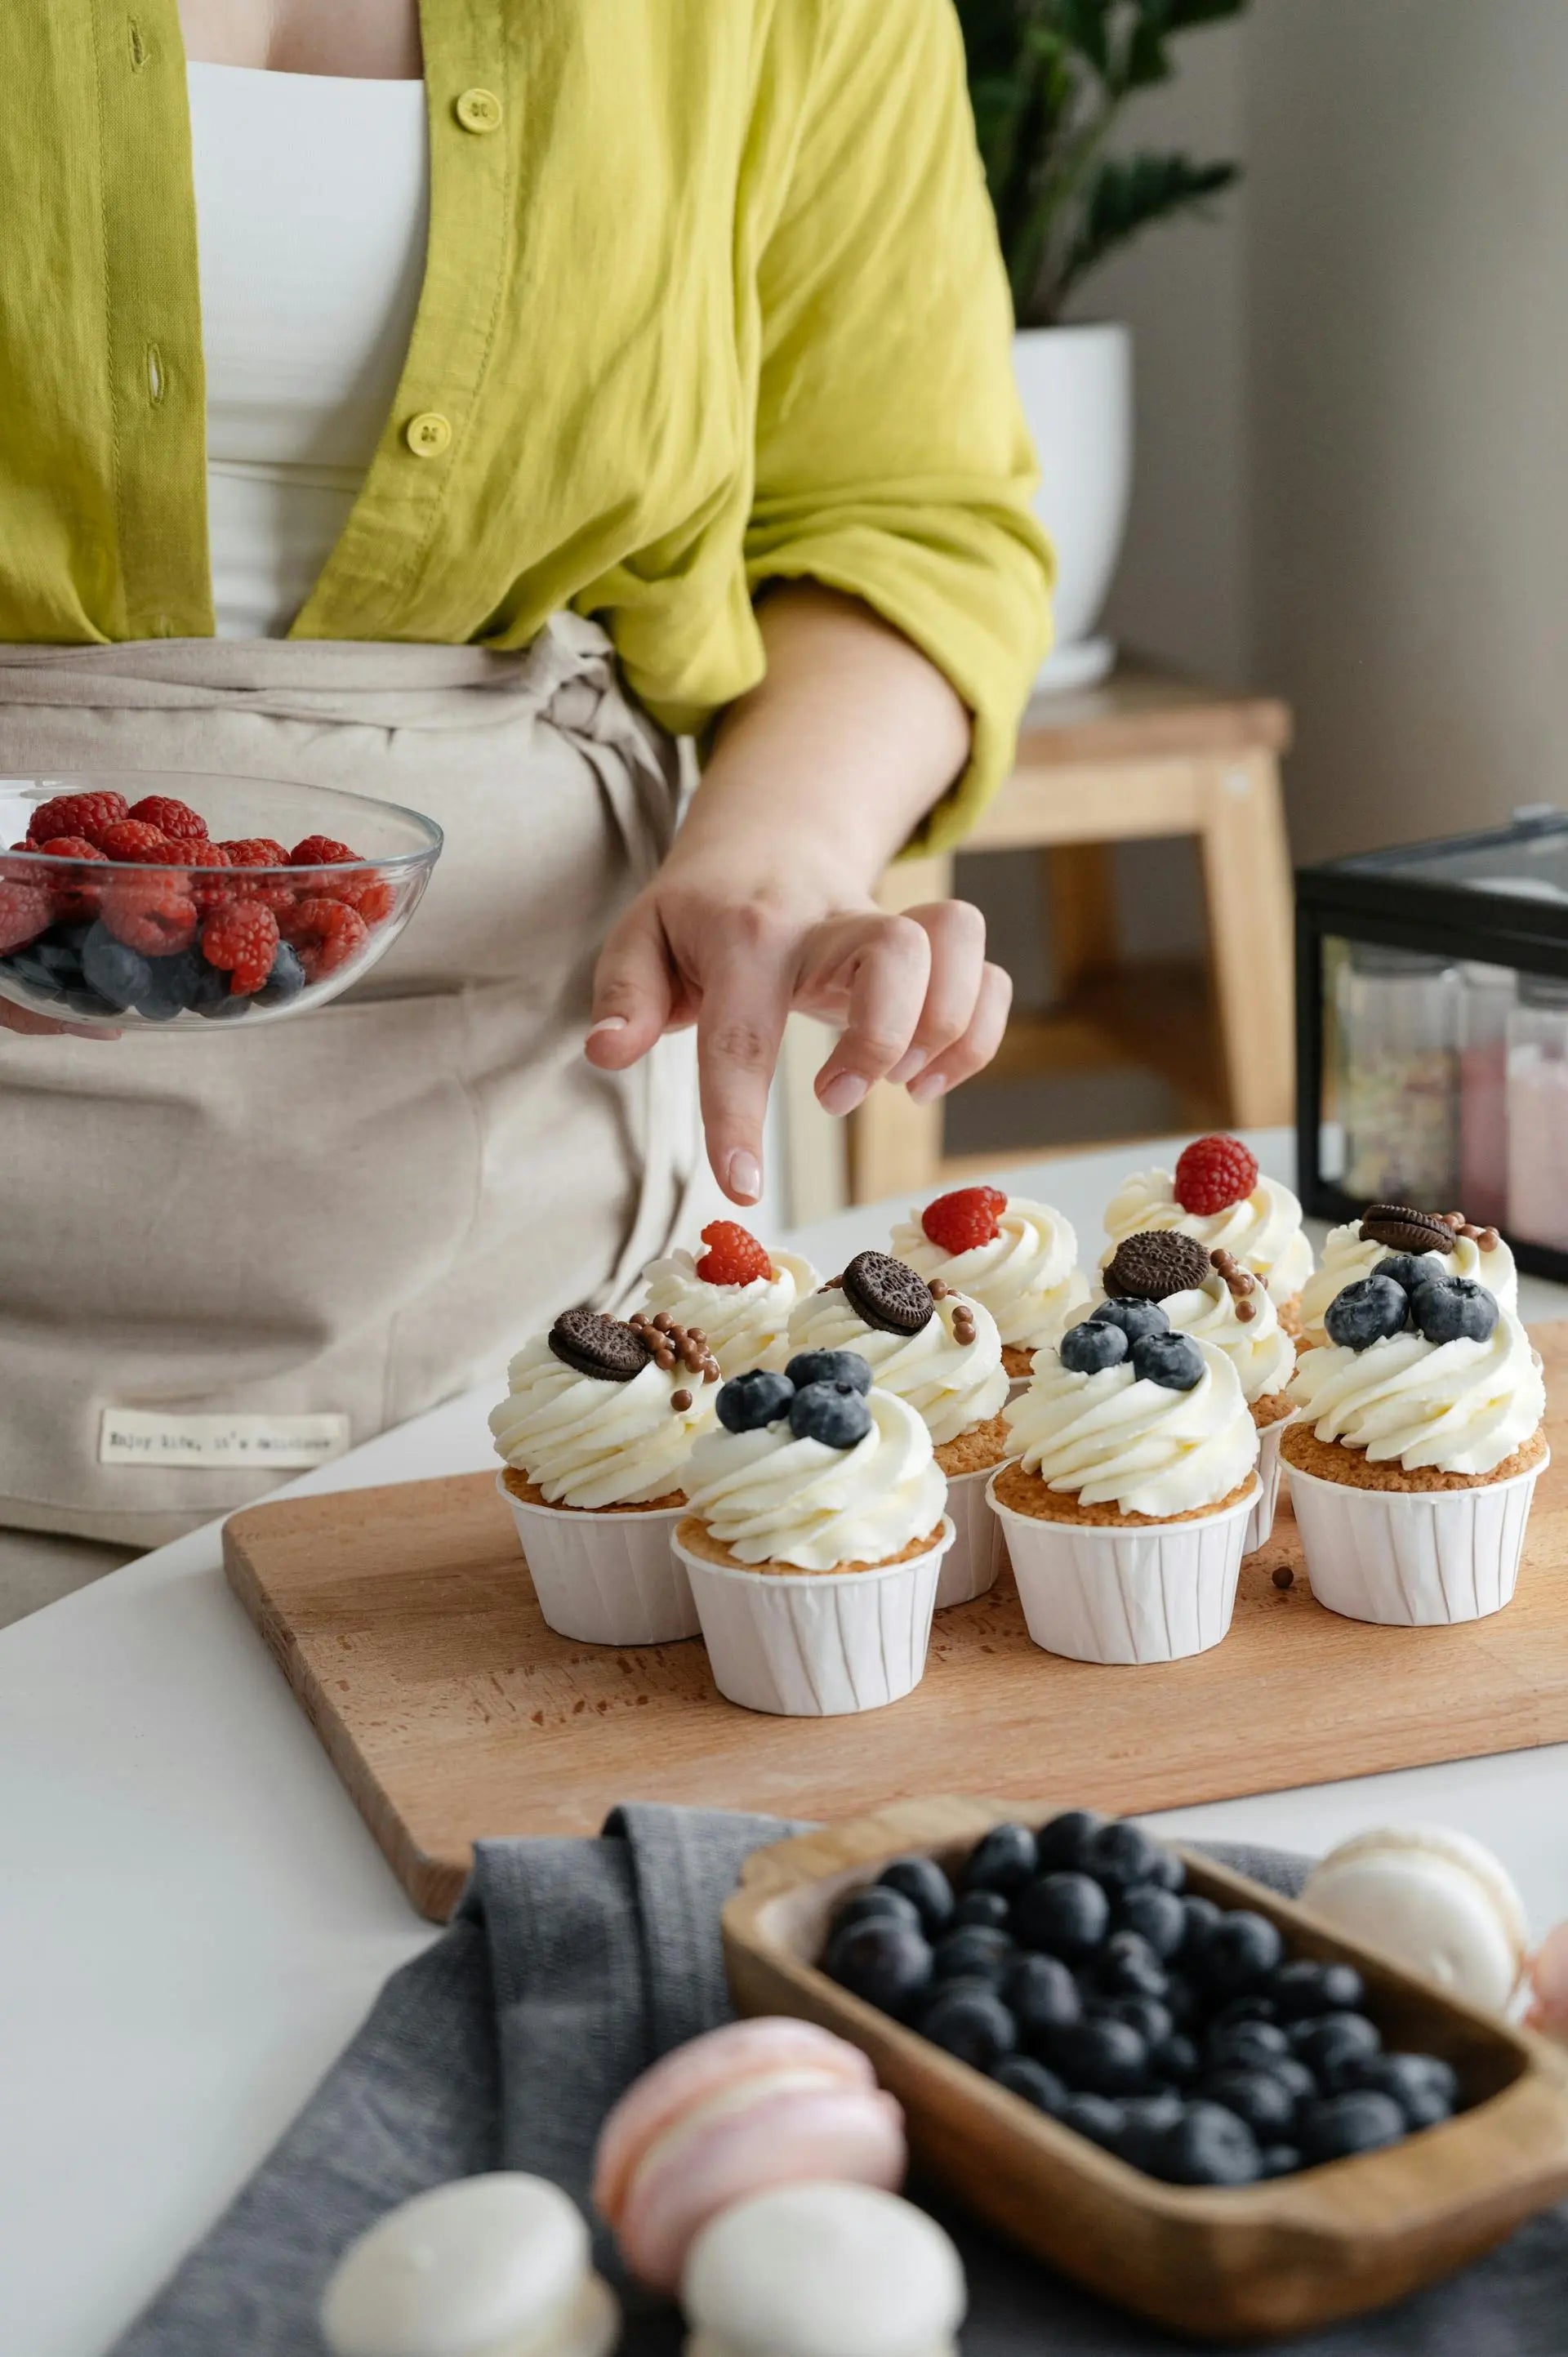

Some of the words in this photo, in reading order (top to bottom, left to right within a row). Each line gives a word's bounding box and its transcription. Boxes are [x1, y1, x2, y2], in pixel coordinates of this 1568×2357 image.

[109, 1432, 152, 1451] Enjoy
[162, 1432, 203, 1451] life,
[213, 1431, 248, 1450] it's
